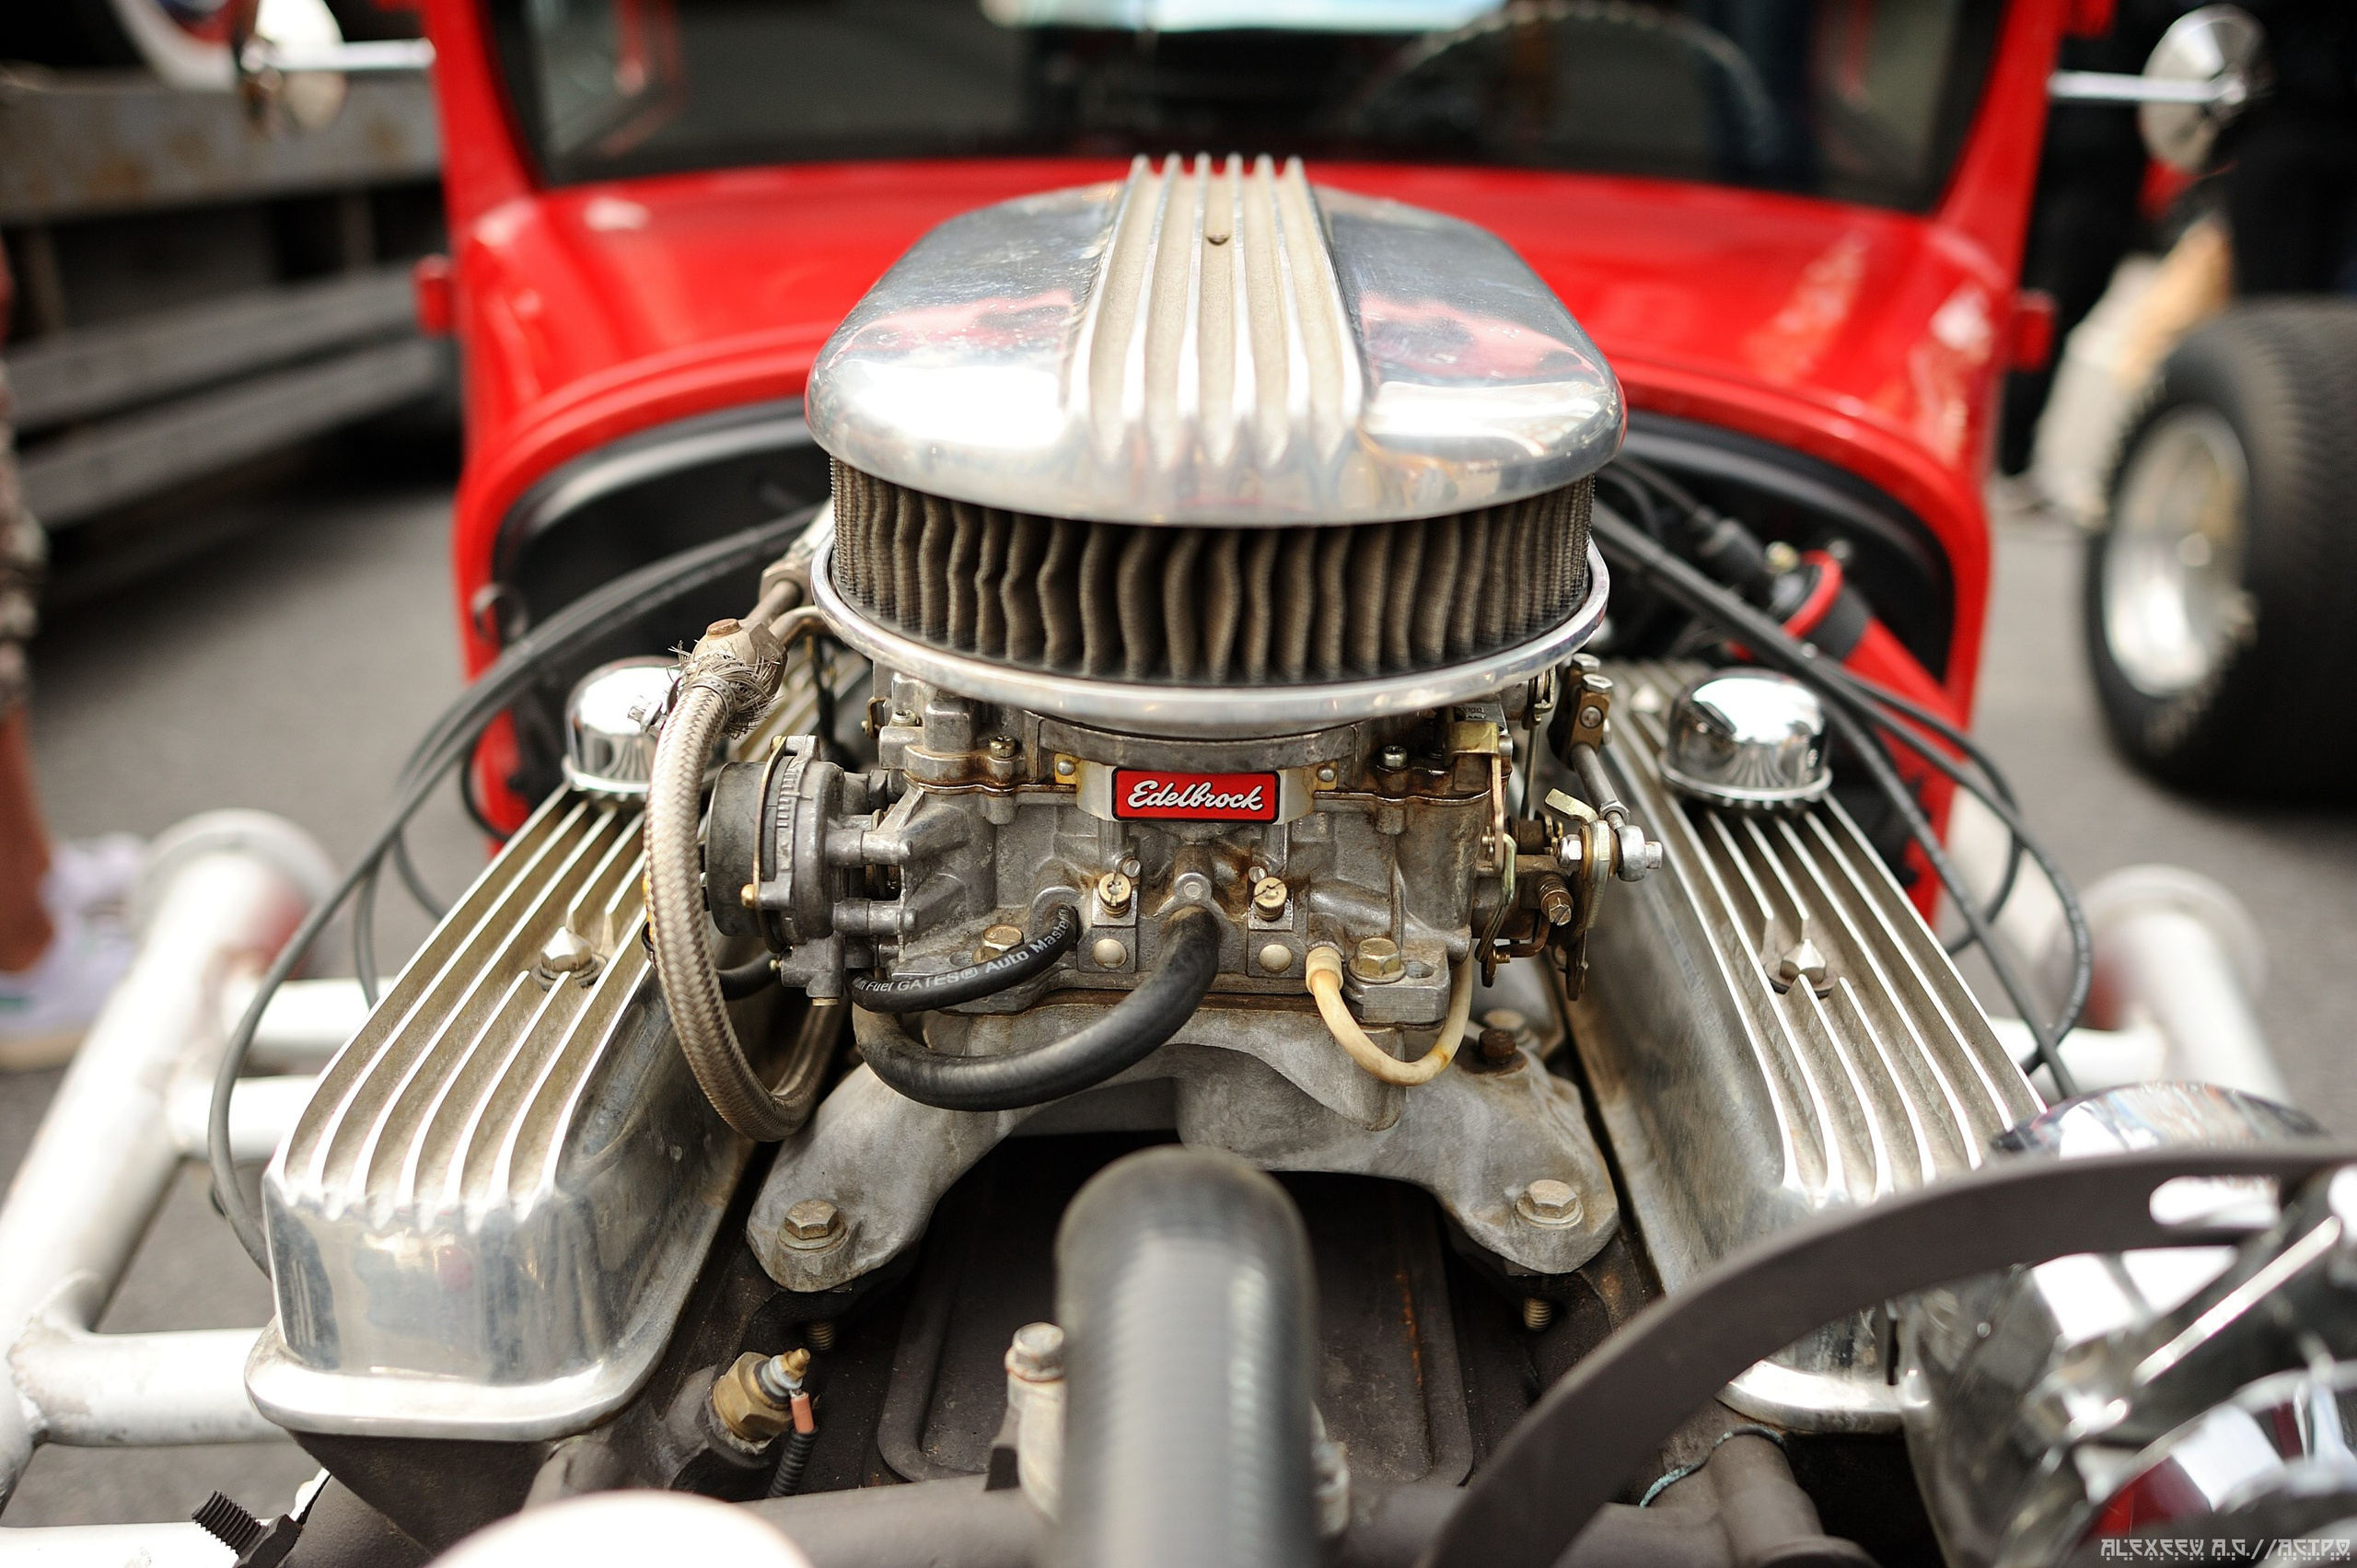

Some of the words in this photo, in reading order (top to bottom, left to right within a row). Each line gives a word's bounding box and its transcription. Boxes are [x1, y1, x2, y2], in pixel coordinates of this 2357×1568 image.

[1127, 779, 1264, 811] Edelbrock
[865, 981, 895, 992] Fuel
[985, 950, 1029, 973] Auto
